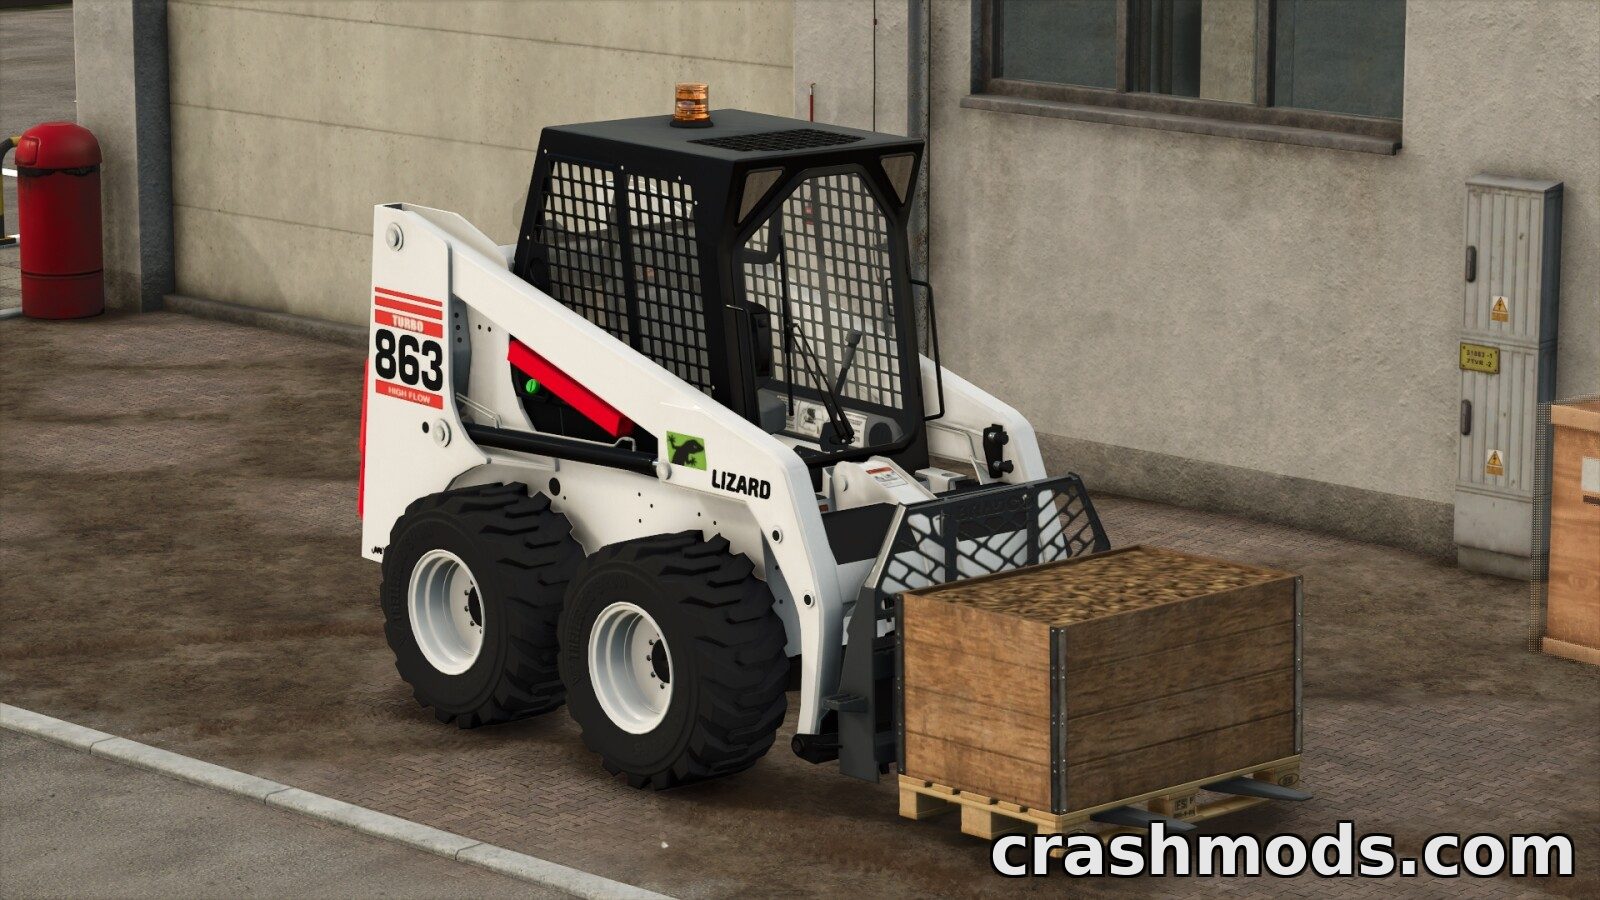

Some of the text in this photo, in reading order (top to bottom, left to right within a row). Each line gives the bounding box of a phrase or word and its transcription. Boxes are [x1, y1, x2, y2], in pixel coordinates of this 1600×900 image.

[392, 315, 424, 332] TURBO
[375, 328, 443, 392] 863
[389, 387, 430, 403] HIGH FLOW
[712, 469, 771, 499] LIZARD
